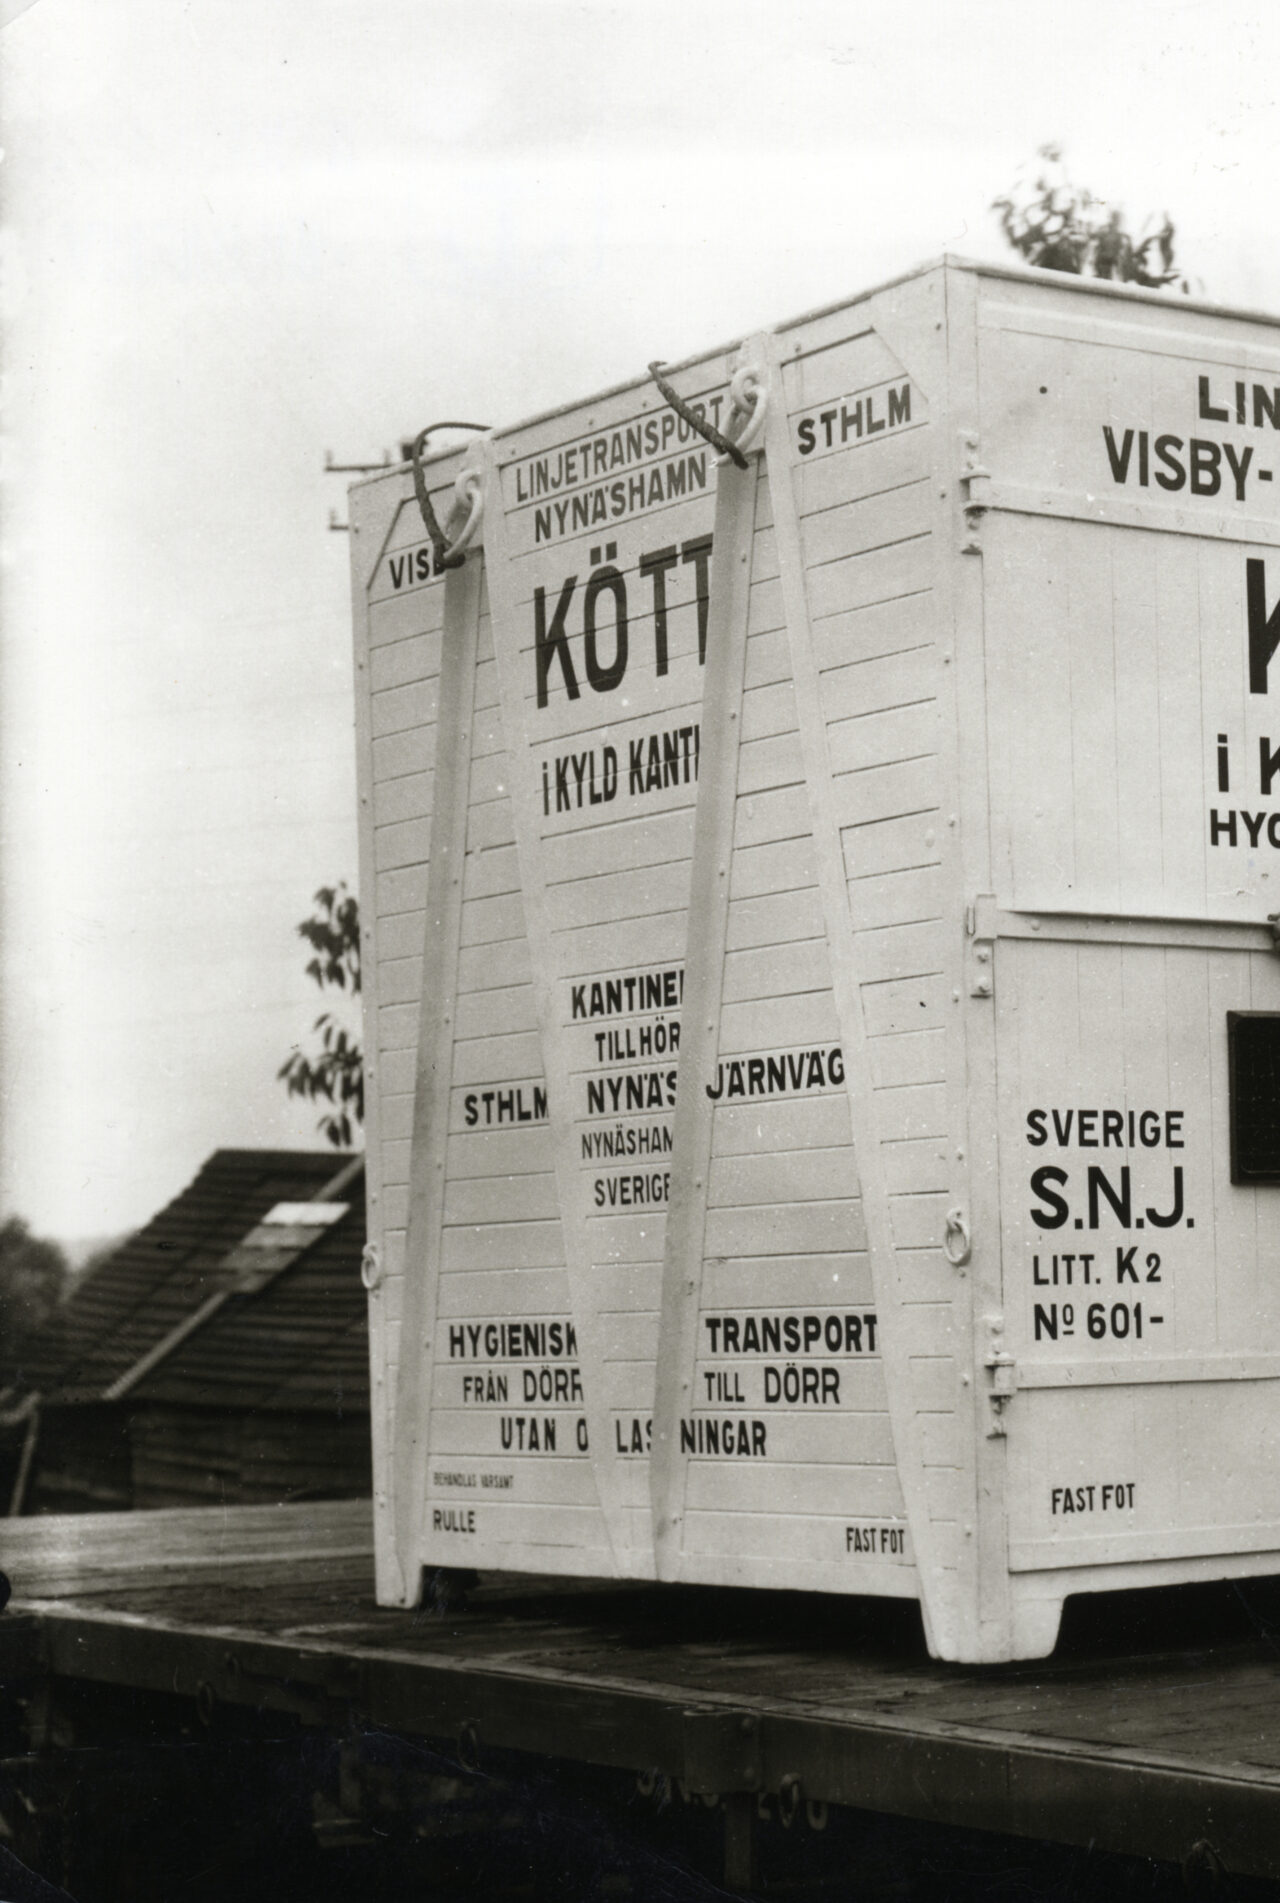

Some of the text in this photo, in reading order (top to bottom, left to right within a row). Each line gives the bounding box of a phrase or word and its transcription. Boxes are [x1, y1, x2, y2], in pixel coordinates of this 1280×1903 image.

[516, 395, 724, 502] LINJETRANSPORT
[535, 452, 706, 543] NYNÄSHAMN
[797, 384, 912, 456] STHLM
[534, 532, 714, 709] KÖTT
[555, 746, 618, 812] KYLD
[595, 1016, 681, 1062] TILLHÖR
[465, 1048, 845, 1126] STHLM NYNÄS JÄRNVÄG
[1026, 1109, 1184, 1148] SVERIGE
[594, 1172, 671, 1207] SVERIGE
[1030, 1165, 1195, 1230] S.N.J.
[1033, 1254, 1101, 1285] LITT.
[449, 1314, 878, 1358] HYGIENISK TRANSPORT
[463, 1361, 840, 1404] FRÅN DÖRR TILL DÖRR
[501, 1417, 556, 1451] UTAN
[1051, 1483, 1136, 1515] FAST FOT
[433, 1509, 476, 1534] RULLE
[846, 1527, 905, 1555] FAST FOT
